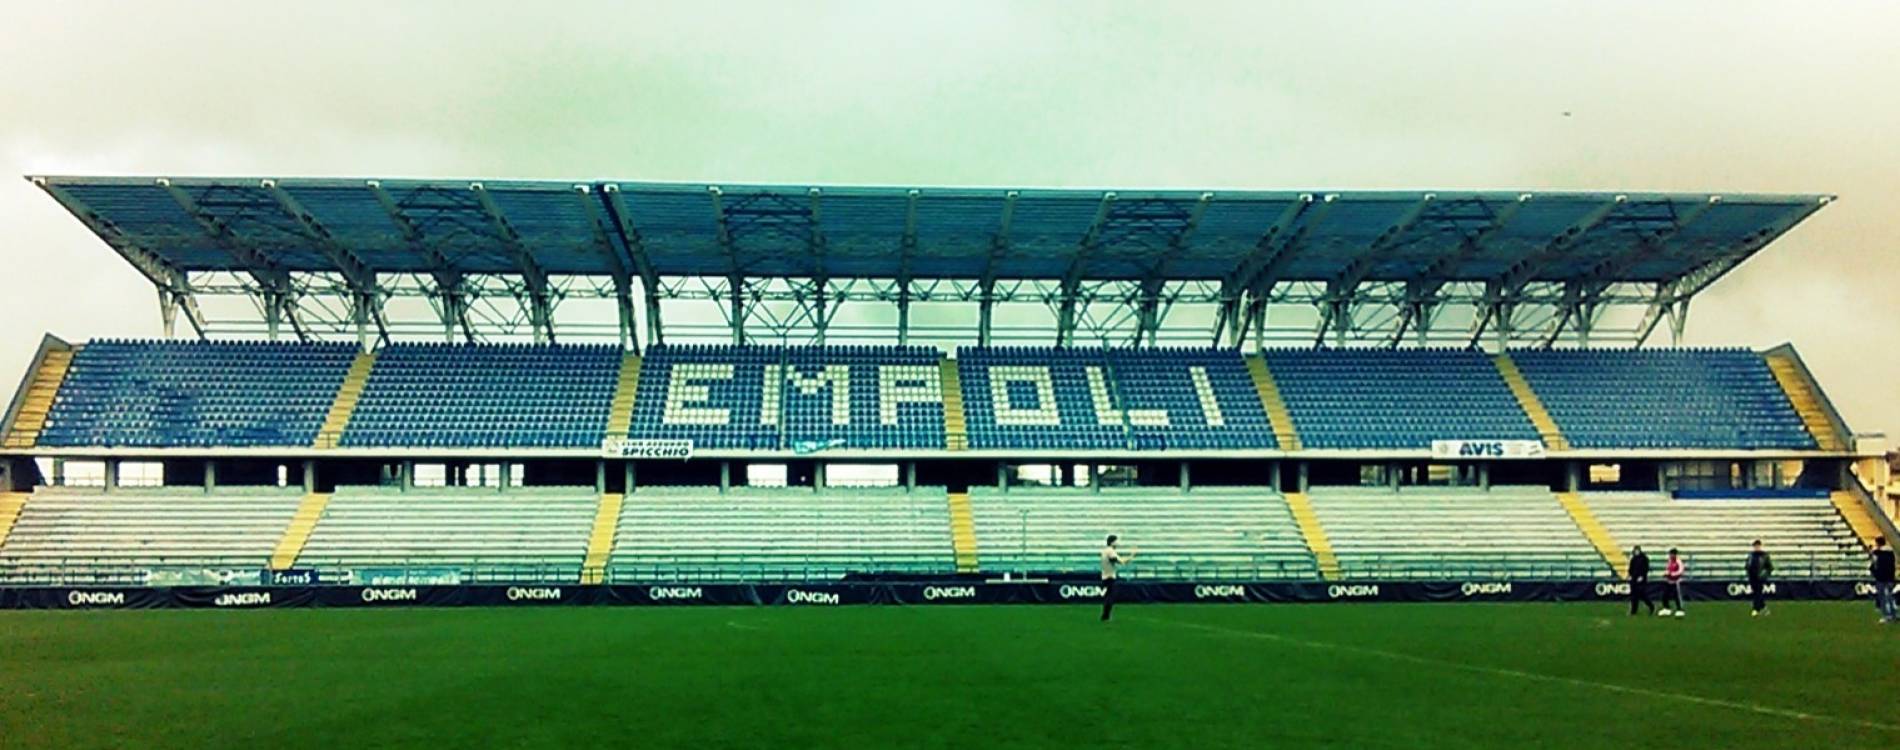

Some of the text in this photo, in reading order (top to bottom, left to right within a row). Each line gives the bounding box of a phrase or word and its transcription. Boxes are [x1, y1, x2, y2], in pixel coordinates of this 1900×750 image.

[663, 364, 1225, 426] EMPOLI
[622, 447, 689, 456] SPICCHIO
[1459, 442, 1504, 456] AVIS
